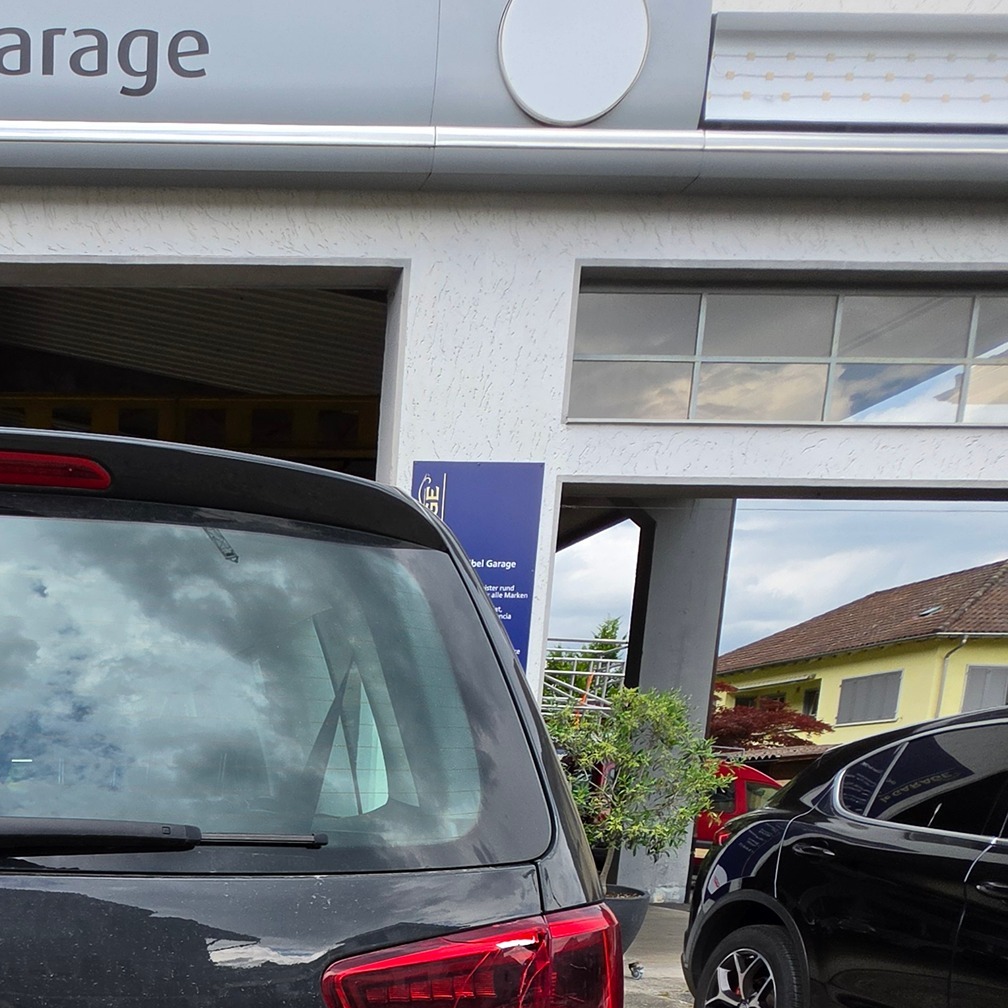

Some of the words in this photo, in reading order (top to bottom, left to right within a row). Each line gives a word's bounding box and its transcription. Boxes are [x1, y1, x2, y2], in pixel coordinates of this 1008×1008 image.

[486, 559, 517, 570] Garage
[499, 584, 515, 592] rund
[491, 591, 503, 599] alle
